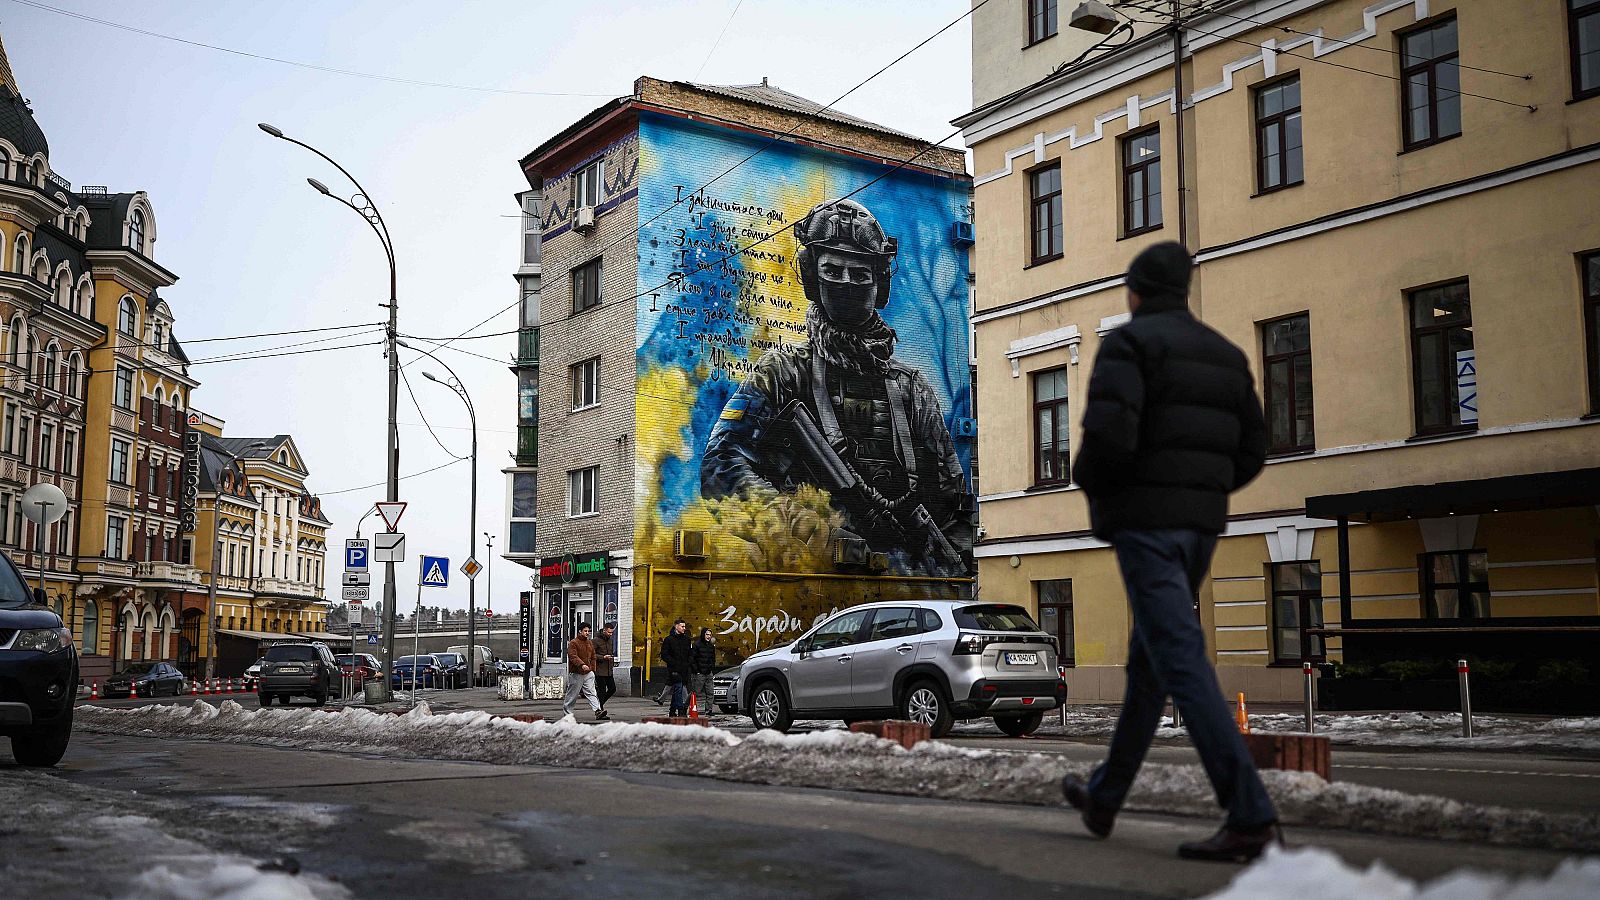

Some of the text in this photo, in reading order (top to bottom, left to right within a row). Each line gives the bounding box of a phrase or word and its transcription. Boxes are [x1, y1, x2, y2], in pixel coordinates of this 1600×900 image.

[673, 185, 684, 203] І
[695, 212, 706, 230] І
[678, 249, 689, 267] І
[648, 293, 661, 312] І
[676, 320, 688, 340] І
[350, 549, 365, 565] P
[576, 557, 606, 574] market
[716, 605, 804, 650] Заради
